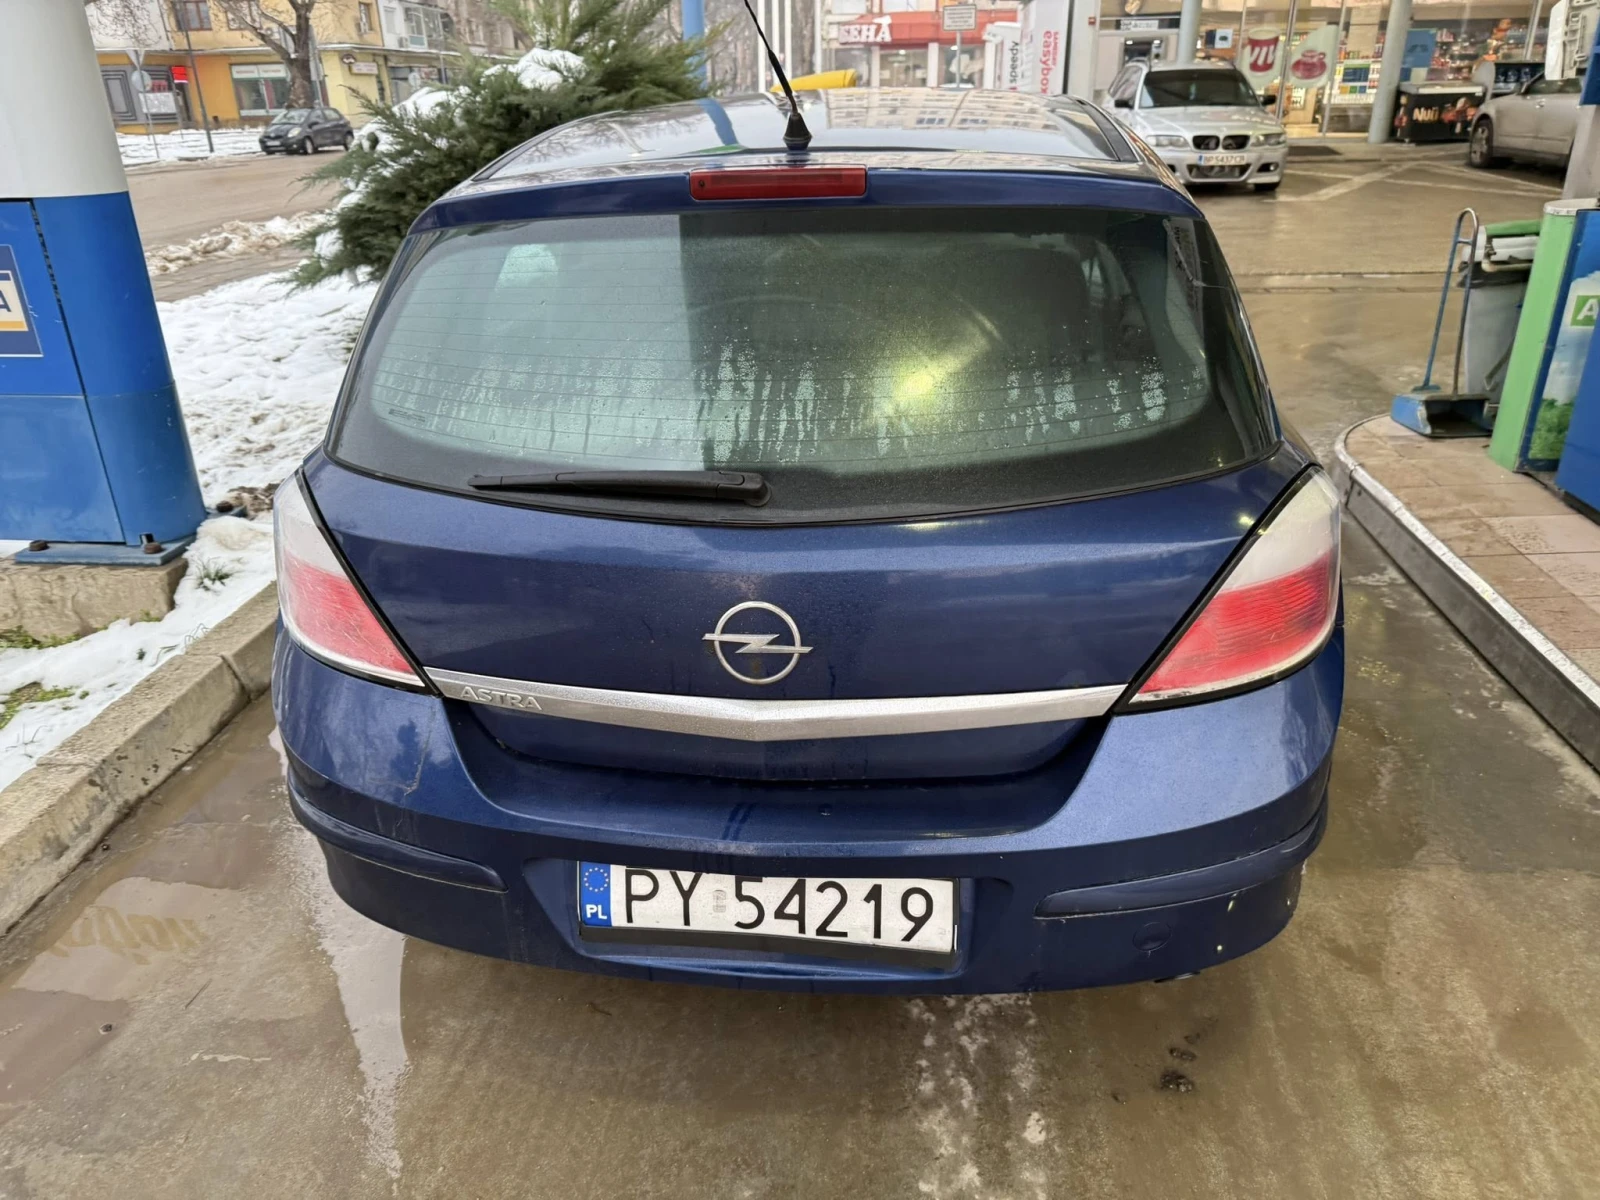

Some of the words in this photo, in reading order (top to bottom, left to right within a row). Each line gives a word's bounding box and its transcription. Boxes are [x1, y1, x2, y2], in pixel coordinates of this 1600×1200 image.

[1008, 41, 1019, 84] speedy
[1040, 30, 1053, 94] easybox
[460, 686, 542, 710] ASTRA
[586, 904, 608, 920] PL
[625, 869, 703, 925] PY
[735, 875, 934, 941] 54219
